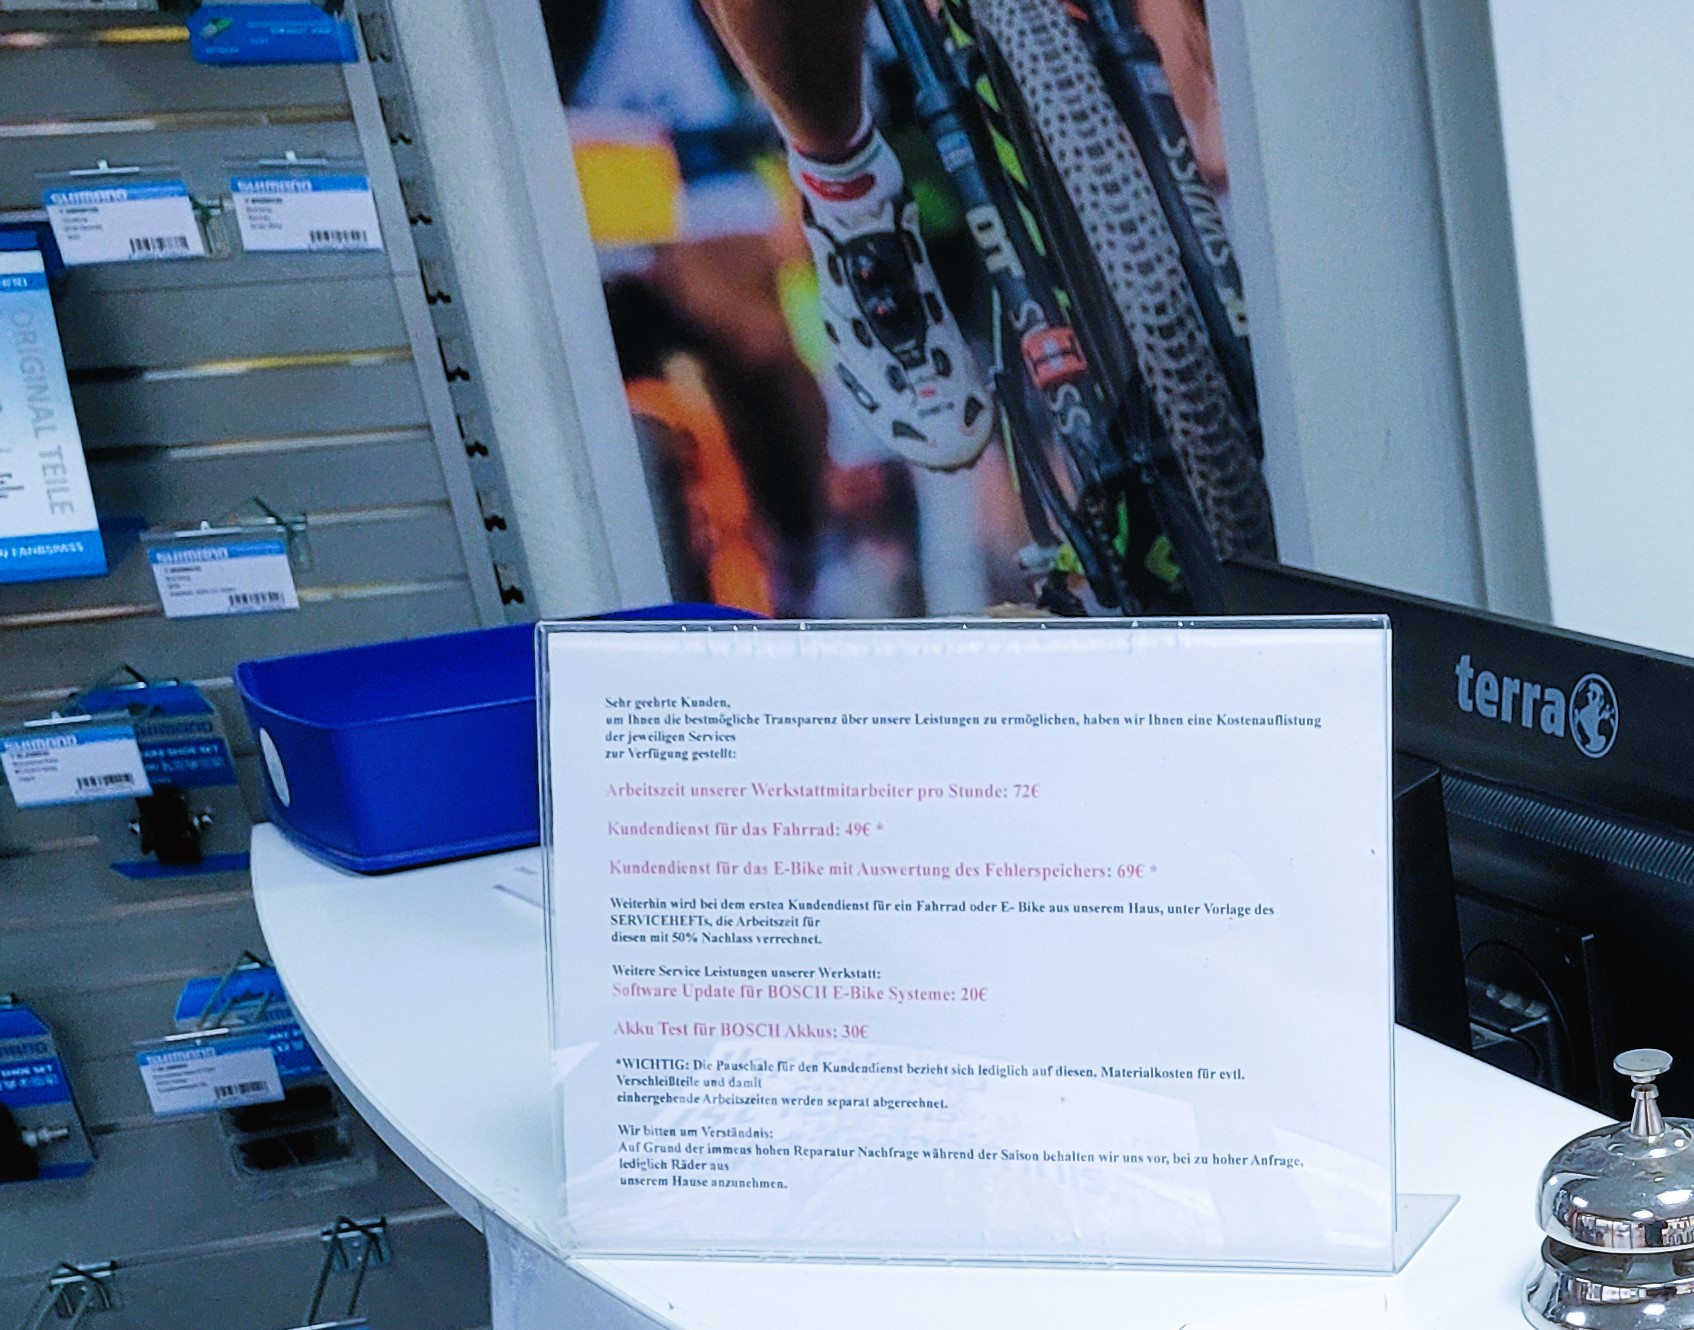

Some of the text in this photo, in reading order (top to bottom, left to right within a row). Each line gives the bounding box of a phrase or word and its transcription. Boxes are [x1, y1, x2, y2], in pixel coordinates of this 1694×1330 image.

[9, 307, 58, 439] ORIGINAL
[40, 445, 75, 515] TEILE
[605, 695, 732, 711] Sehr geehrte Kunden,
[1454, 653, 1566, 739] terra
[605, 712, 1322, 729] um Ihnen die bestmögliche Transparenz über unsere Leistungen zu ermöglichen, haben wir Ihnen eine Kostenauflistung
[604, 730, 625, 742] der
[605, 747, 737, 762] zur Verfügung gestellt:
[605, 782, 1039, 802] Arbeitszeit unserer Werkstattmitarbeiter pro Stunde: 72€
[608, 821, 871, 837] Kundendienst für das Fahrrad: 49€
[610, 860, 1145, 882] Kundendienst für das E-Bike mit Auswertung des Fehlerspeichers: 69€
[609, 897, 668, 910] Weiterhin
[669, 897, 697, 910] wird
[699, 897, 718, 910] bei
[720, 898, 746, 910] dem
[748, 900, 785, 911] ersten
[788, 898, 870, 911] Kundendienst
[872, 899, 892, 912] für
[894, 899, 913, 912] ein
[916, 899, 966, 912] Fahrrad
[969, 900, 998, 913] oder
[1018, 900, 1046, 913] Bike
[1048, 904, 1070, 913] aus
[1072, 904, 1125, 914] unserem
[1128, 901, 1164, 916] Haus,
[1167, 904, 1201, 915] unter
[1203, 902, 1252, 920] Vorlage
[1254, 903, 1275, 916] des
[715, 915, 734, 927] die
[735, 915, 799, 928] Arbeitszeit
[802, 915, 821, 928] für
[610, 930, 823, 945] diesen mit 50% Nachlass verrechnet.
[612, 964, 881, 980] Weitere Service Leistungen unserer Werkstatt:
[612, 982, 988, 1004] Software Update für BOSCH E-Bike Systeme: 20€
[614, 1020, 869, 1039] Akku Test für BOSCH Akkus: 30€
[692, 1058, 713, 1071] Die
[716, 1059, 775, 1072] Pauschale
[776, 1060, 796, 1073] für
[797, 1060, 819, 1073] den
[822, 1061, 903, 1075] Kundendienst
[906, 1062, 949, 1075] bezieht
[951, 1063, 975, 1076] sich
[978, 1064, 1029, 1079] lediglich
[1032, 1065, 1054, 1077] auf
[1055, 1065, 1098, 1078] diesen.
[1100, 1065, 1194, 1080] Materialkosten
[1197, 1067, 1217, 1080] für
[1219, 1068, 1245, 1081] evtl.
